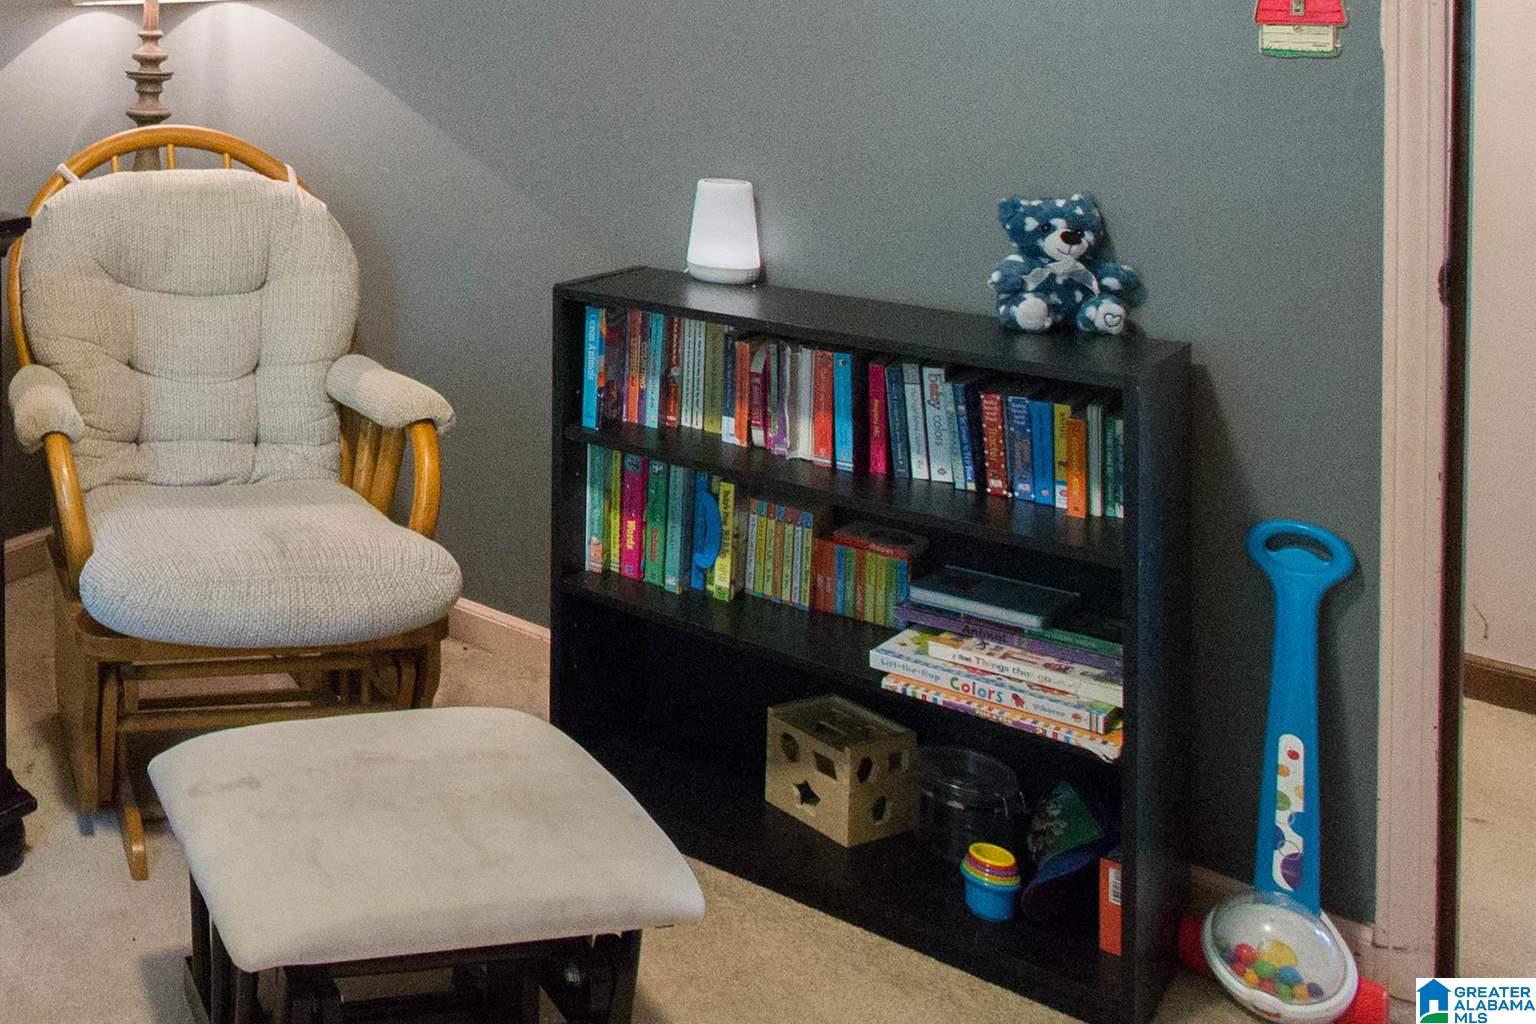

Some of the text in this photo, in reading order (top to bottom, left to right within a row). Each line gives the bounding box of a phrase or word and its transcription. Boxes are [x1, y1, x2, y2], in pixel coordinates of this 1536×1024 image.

[587, 314, 596, 381] Ocean Animals
[933, 415, 947, 446] colors
[987, 427, 999, 462] Tractor
[626, 520, 636, 550] Words
[950, 677, 1004, 704] Colors
